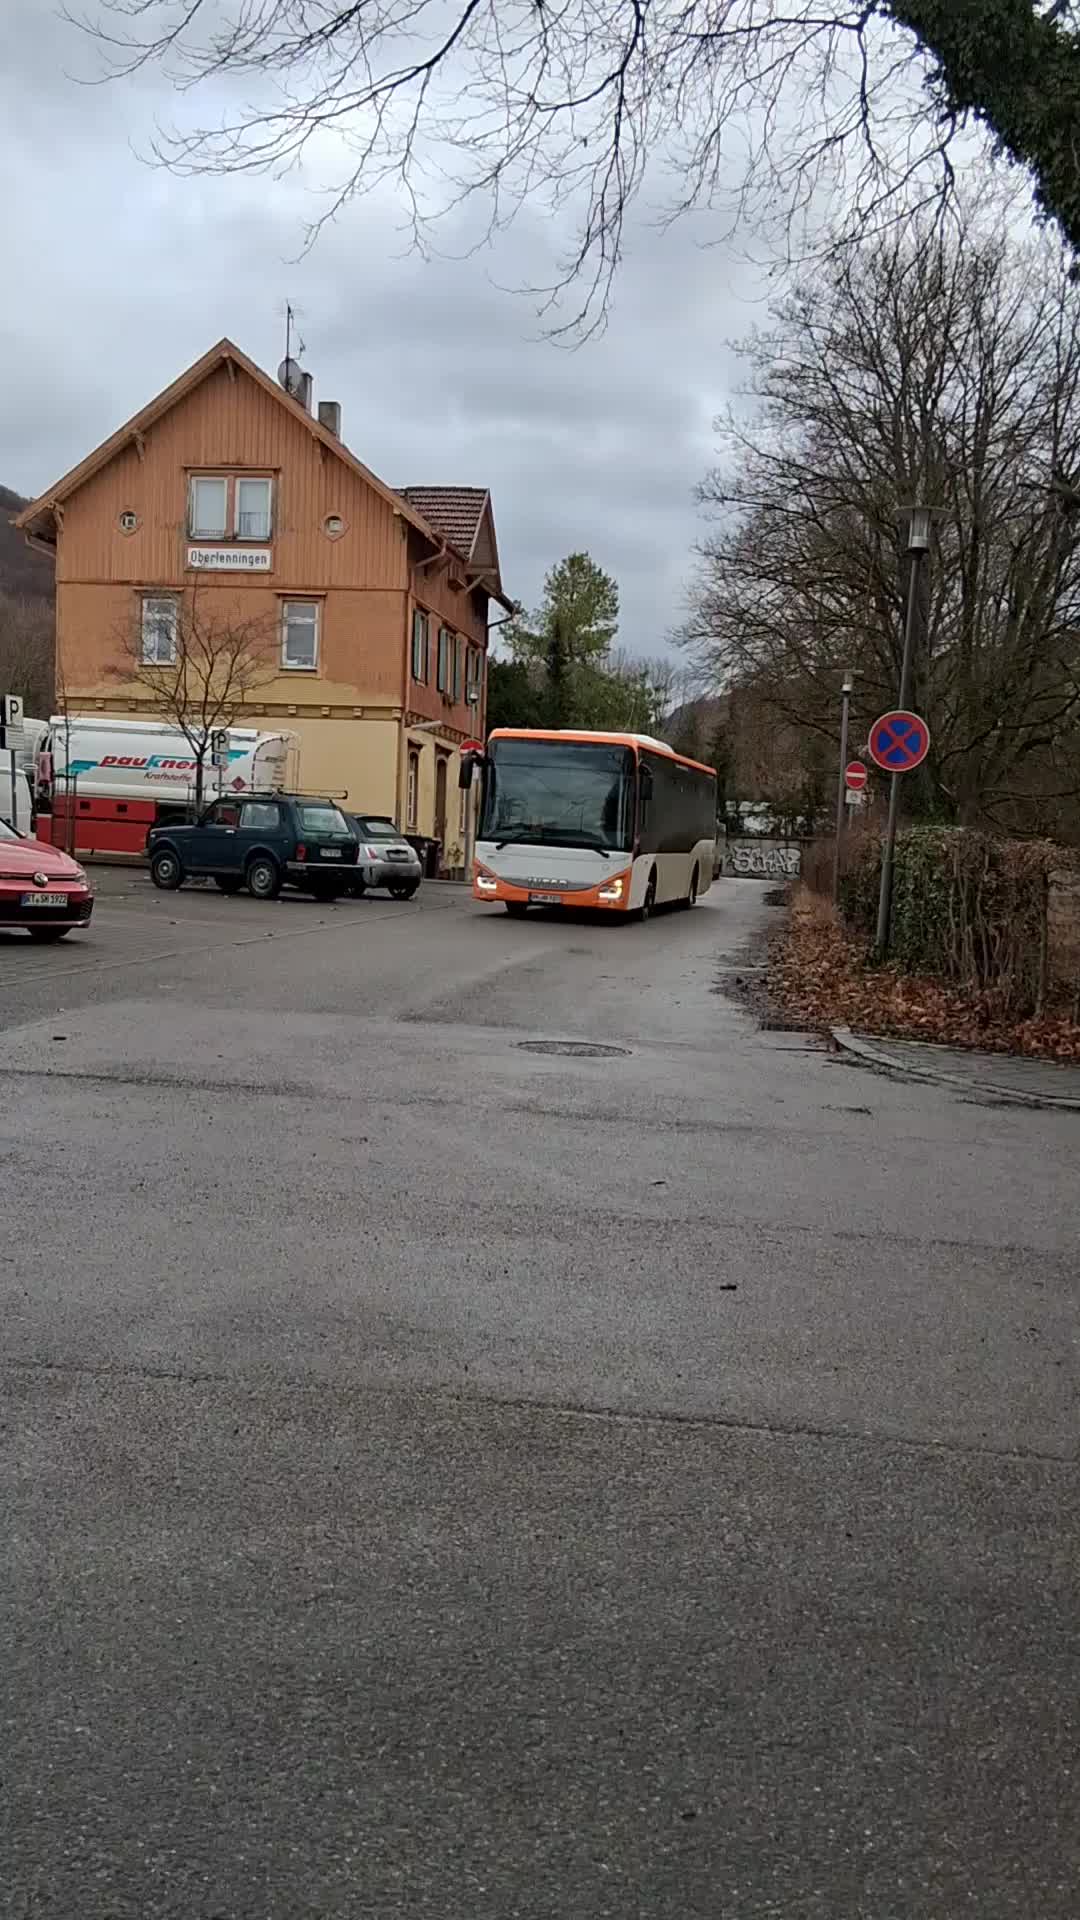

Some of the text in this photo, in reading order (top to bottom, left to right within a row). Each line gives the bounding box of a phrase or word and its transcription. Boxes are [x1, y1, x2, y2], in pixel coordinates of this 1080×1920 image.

[190, 550, 267, 566] Oberlenningen
[10, 701, 20, 722] P
[218, 732, 227, 750] P
